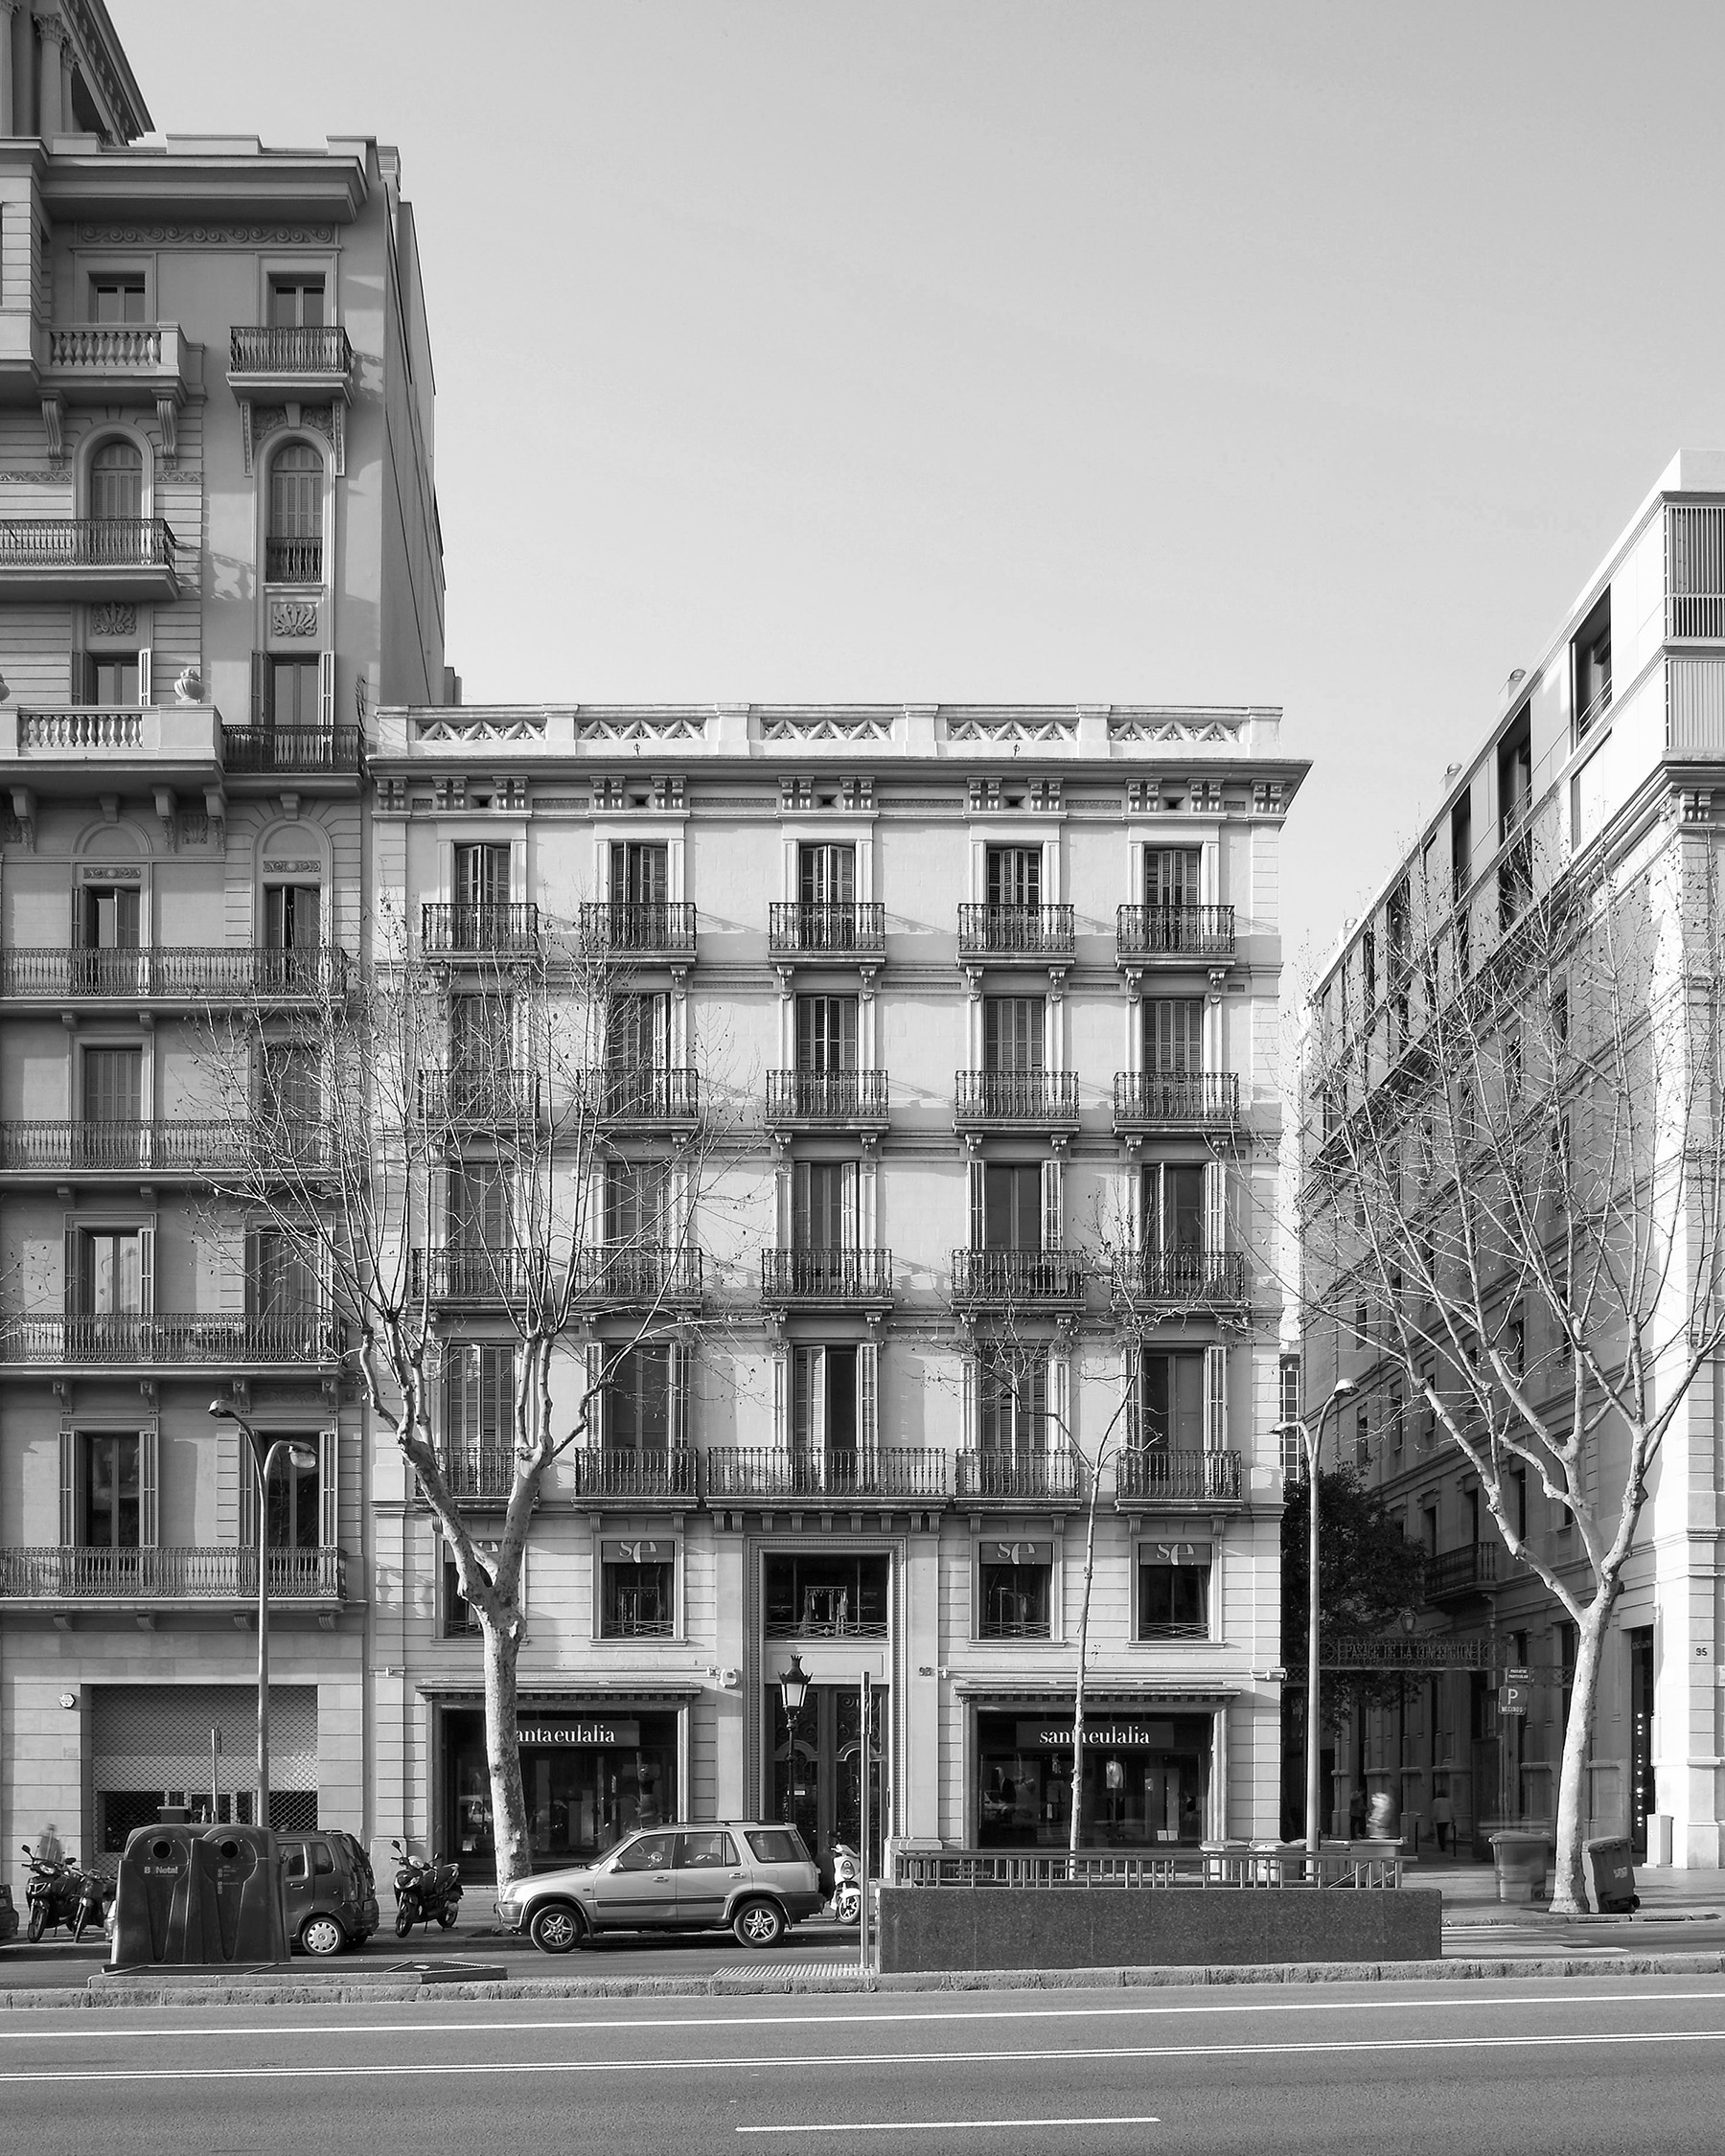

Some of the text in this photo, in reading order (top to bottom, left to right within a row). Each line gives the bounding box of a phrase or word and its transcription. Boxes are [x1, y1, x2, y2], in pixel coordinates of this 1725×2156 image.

[1384, 1643, 1396, 1659] DE
[1400, 1643, 1412, 1659] LA
[1695, 1647, 1708, 1657] 95
[918, 1666, 932, 1677] 93
[1507, 1688, 1519, 1705] P
[517, 1724, 615, 1743] antaeulalia
